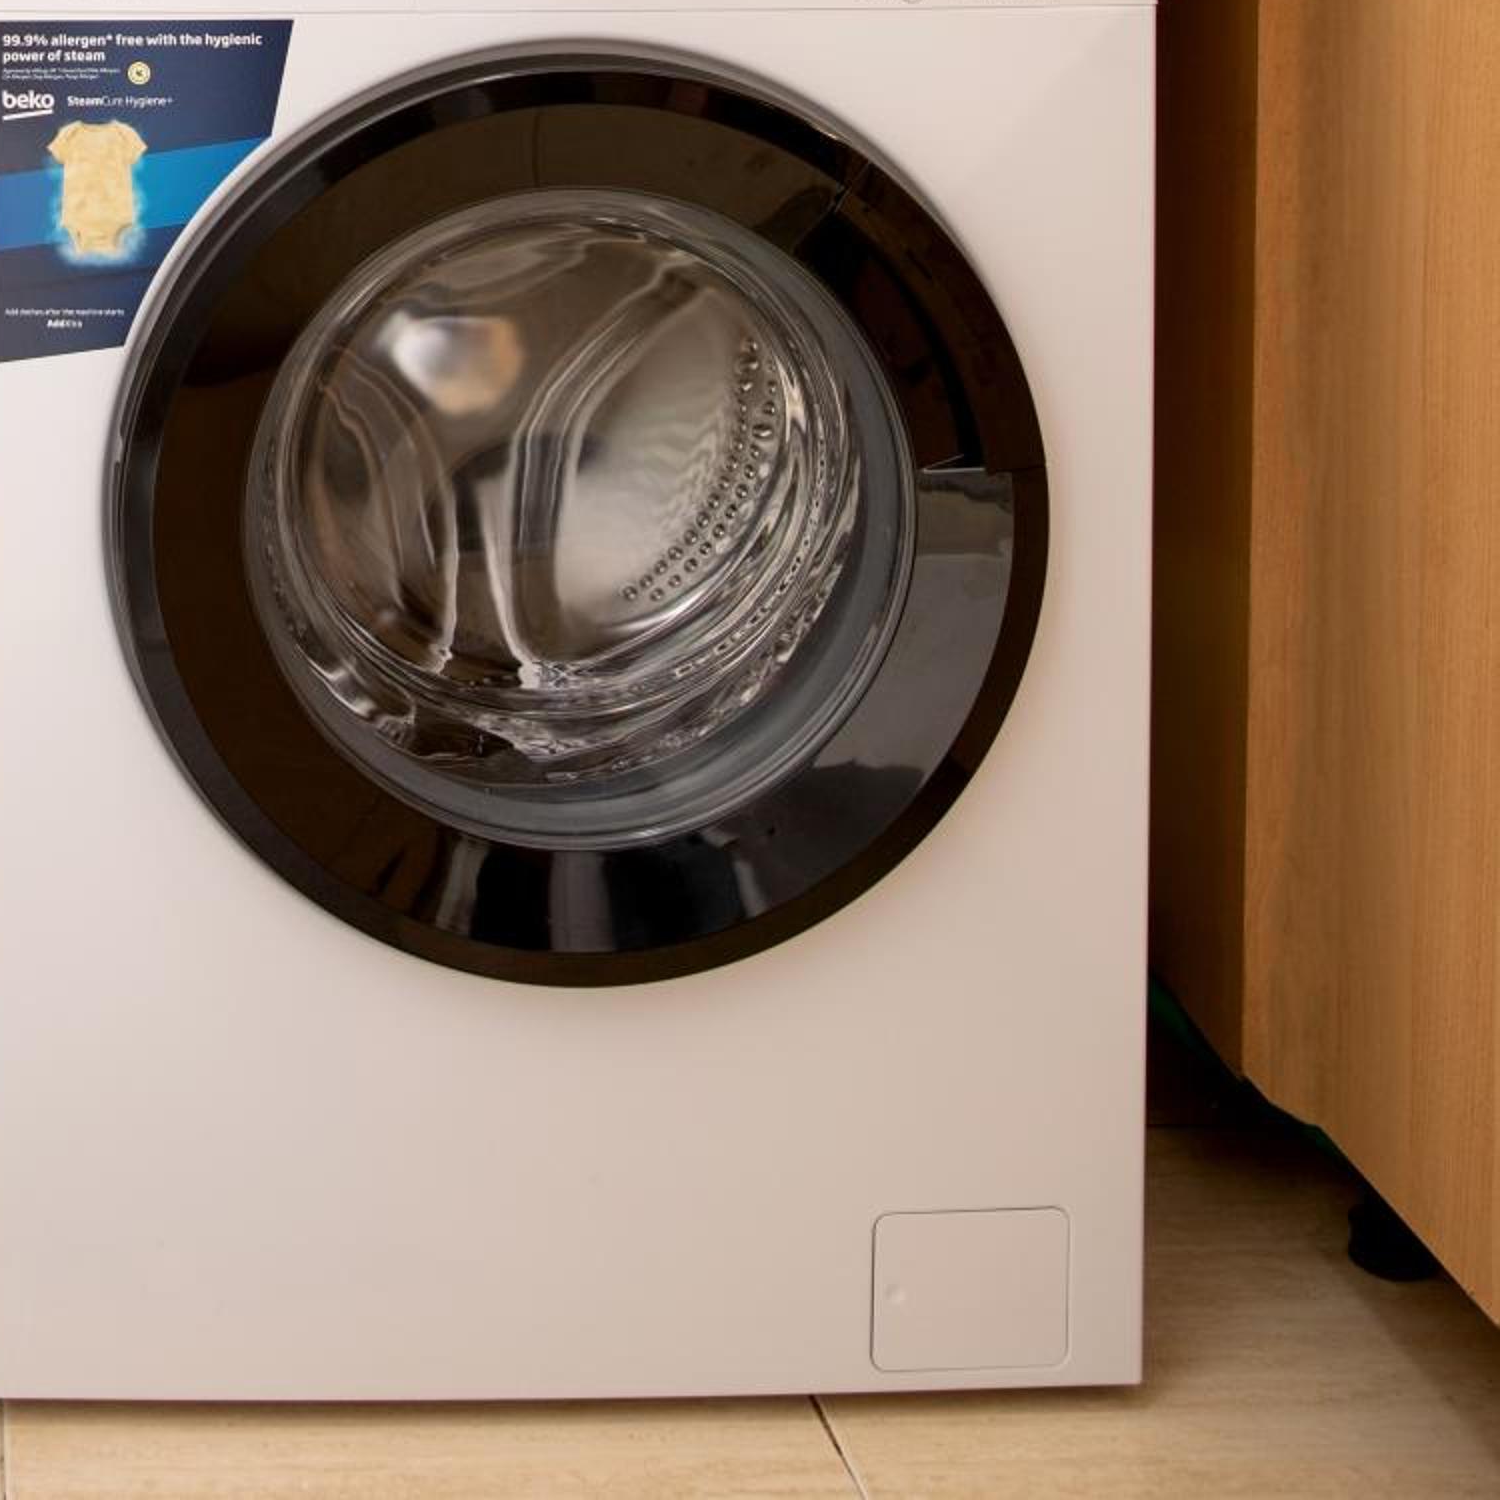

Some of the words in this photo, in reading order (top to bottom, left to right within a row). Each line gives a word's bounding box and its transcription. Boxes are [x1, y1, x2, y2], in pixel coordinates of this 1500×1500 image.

[2, 34, 48, 47] 99.9%
[116, 33, 144, 47] free
[146, 33, 178, 46] with
[179, 33, 202, 46] the
[205, 32, 263, 49] hygienic
[2, 51, 46, 65] power
[48, 49, 61, 62] of
[64, 51, 106, 63] steam
[2, 90, 55, 110] beko
